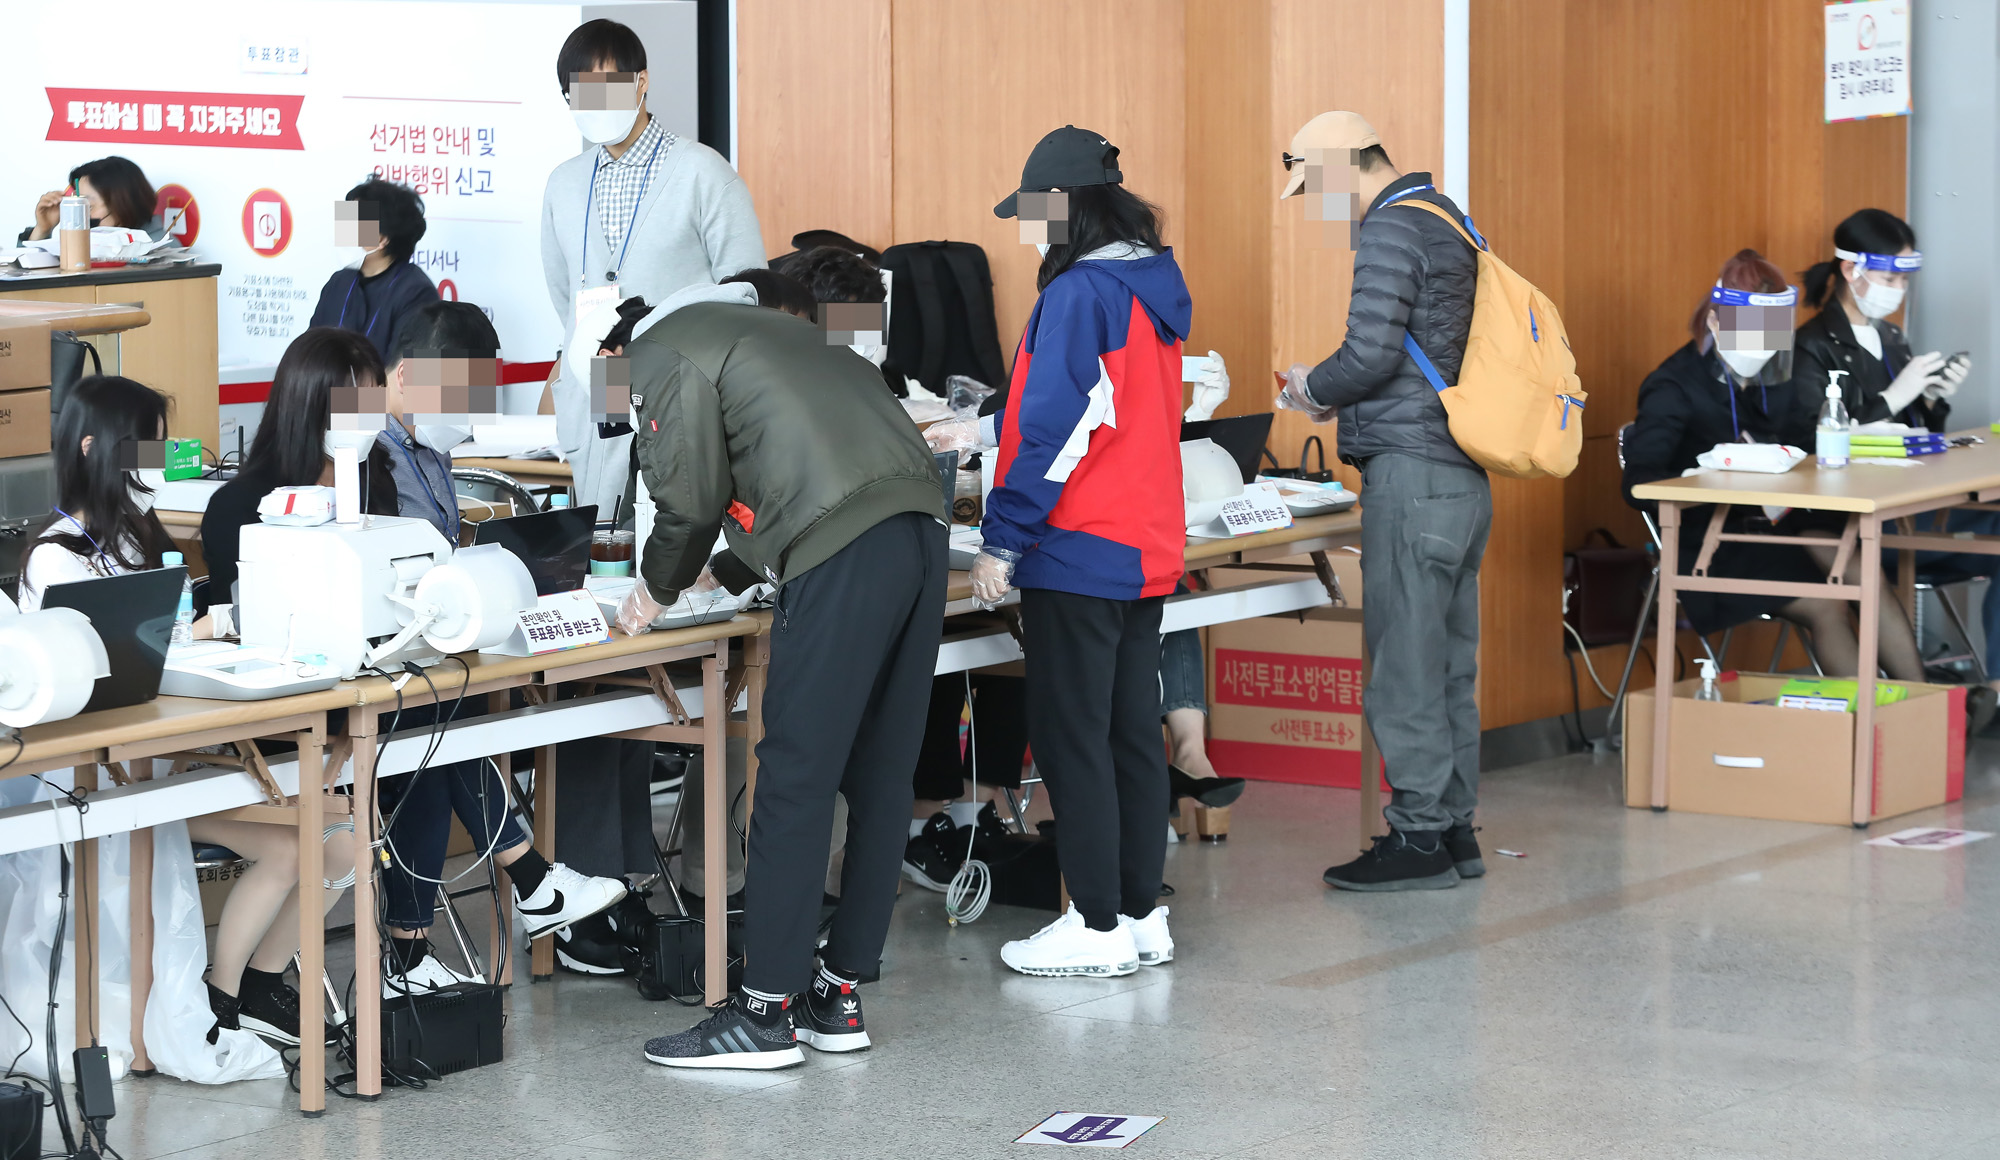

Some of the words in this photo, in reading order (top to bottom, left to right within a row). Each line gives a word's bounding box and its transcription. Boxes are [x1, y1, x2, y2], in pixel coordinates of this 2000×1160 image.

[67, 101, 139, 130] 투표하실
[190, 105, 282, 136] 지켜주세요
[370, 124, 426, 154] 선거법
[433, 126, 470, 156] 안내
[477, 127, 496, 157] 및
[455, 167, 494, 196] 신고
[411, 250, 460, 272] 디서나
[520, 610, 554, 627] 본인확인
[552, 609, 564, 621] 및
[528, 623, 565, 643] 투표용지
[563, 622, 574, 638] 등
[572, 619, 593, 635] 받는
[591, 618, 603, 632] 곳
[1270, 718, 1355, 746] <사전투표소용>
